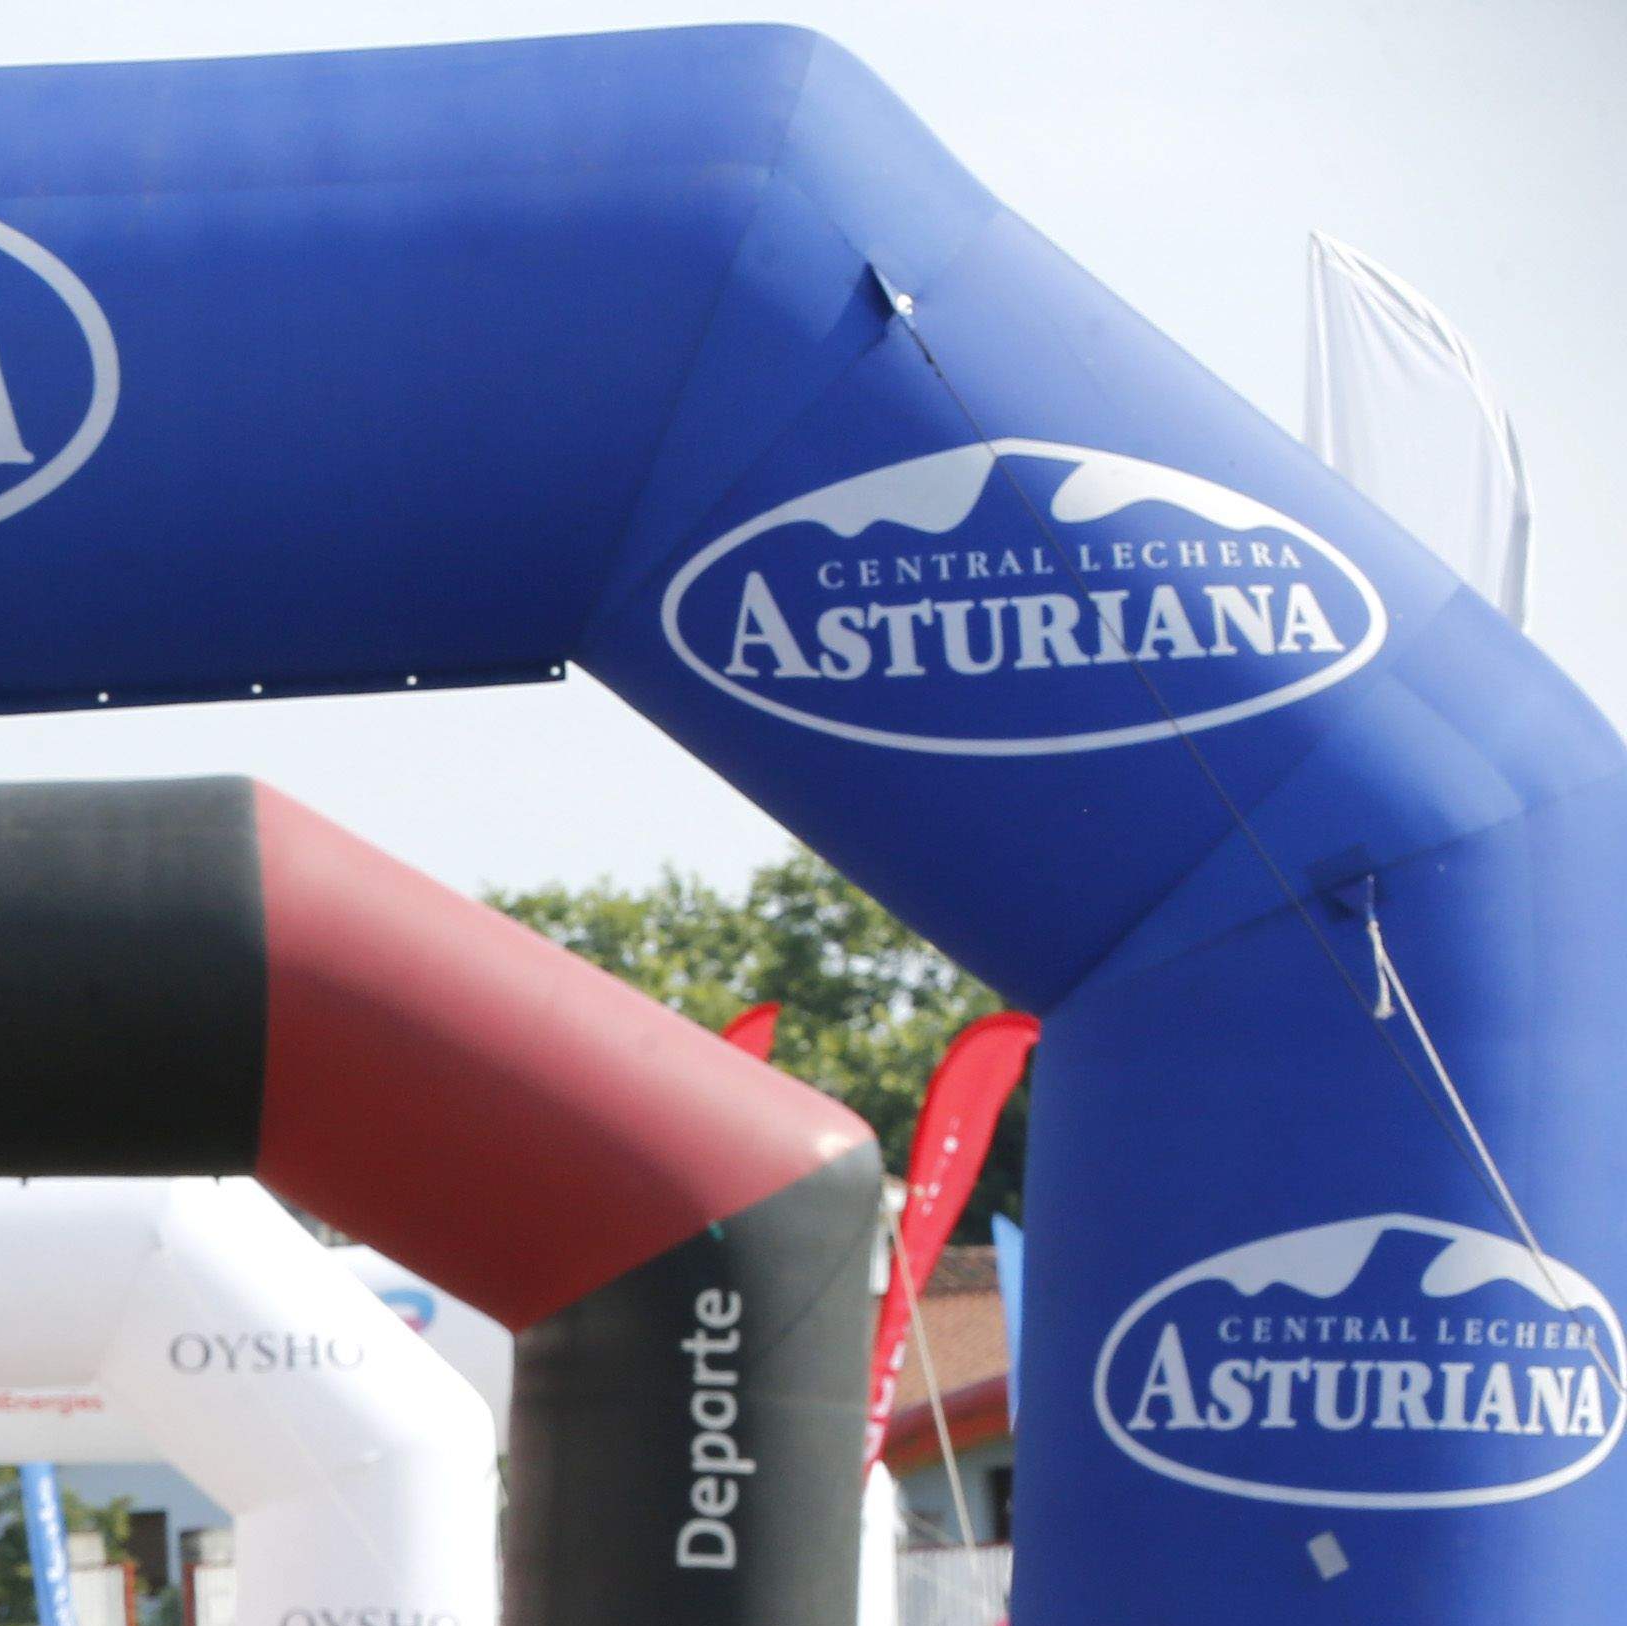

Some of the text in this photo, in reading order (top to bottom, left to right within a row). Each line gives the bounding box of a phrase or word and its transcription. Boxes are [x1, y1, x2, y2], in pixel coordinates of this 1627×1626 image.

[816, 540, 1302, 590] CENTRAL LECHERA
[725, 570, 1344, 681] ASTURIANA
[168, 1331, 364, 1374] OYSHO
[1218, 1316, 1598, 1352] CENTRAL LECHERA
[1127, 1322, 1606, 1438] ASTURIANA
[676, 1286, 757, 1571] Deporte
